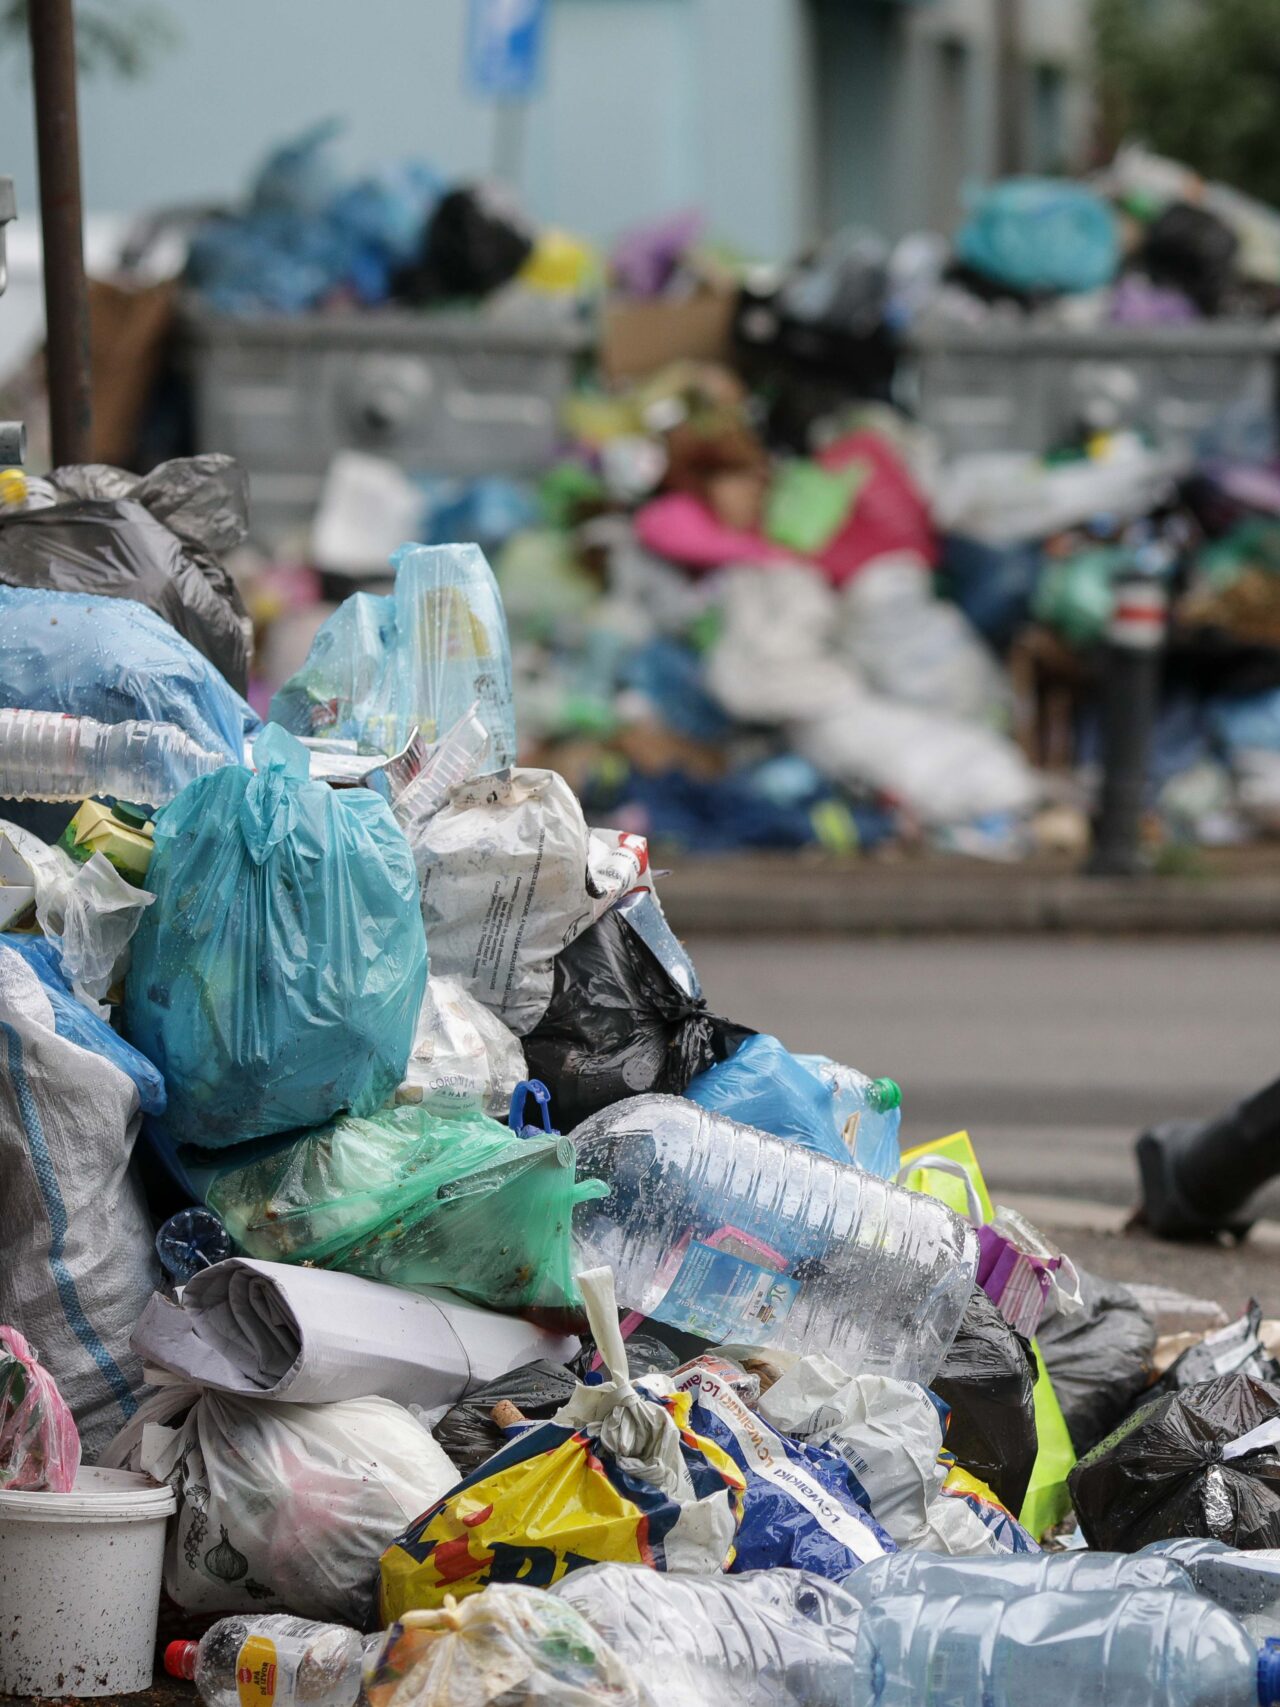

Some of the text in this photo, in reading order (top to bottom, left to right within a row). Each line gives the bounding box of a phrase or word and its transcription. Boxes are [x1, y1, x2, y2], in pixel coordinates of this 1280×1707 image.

[702, 1379, 721, 1398] LC
[253, 1670, 261, 1686] APA
[261, 1661, 269, 1685] IZVOR
